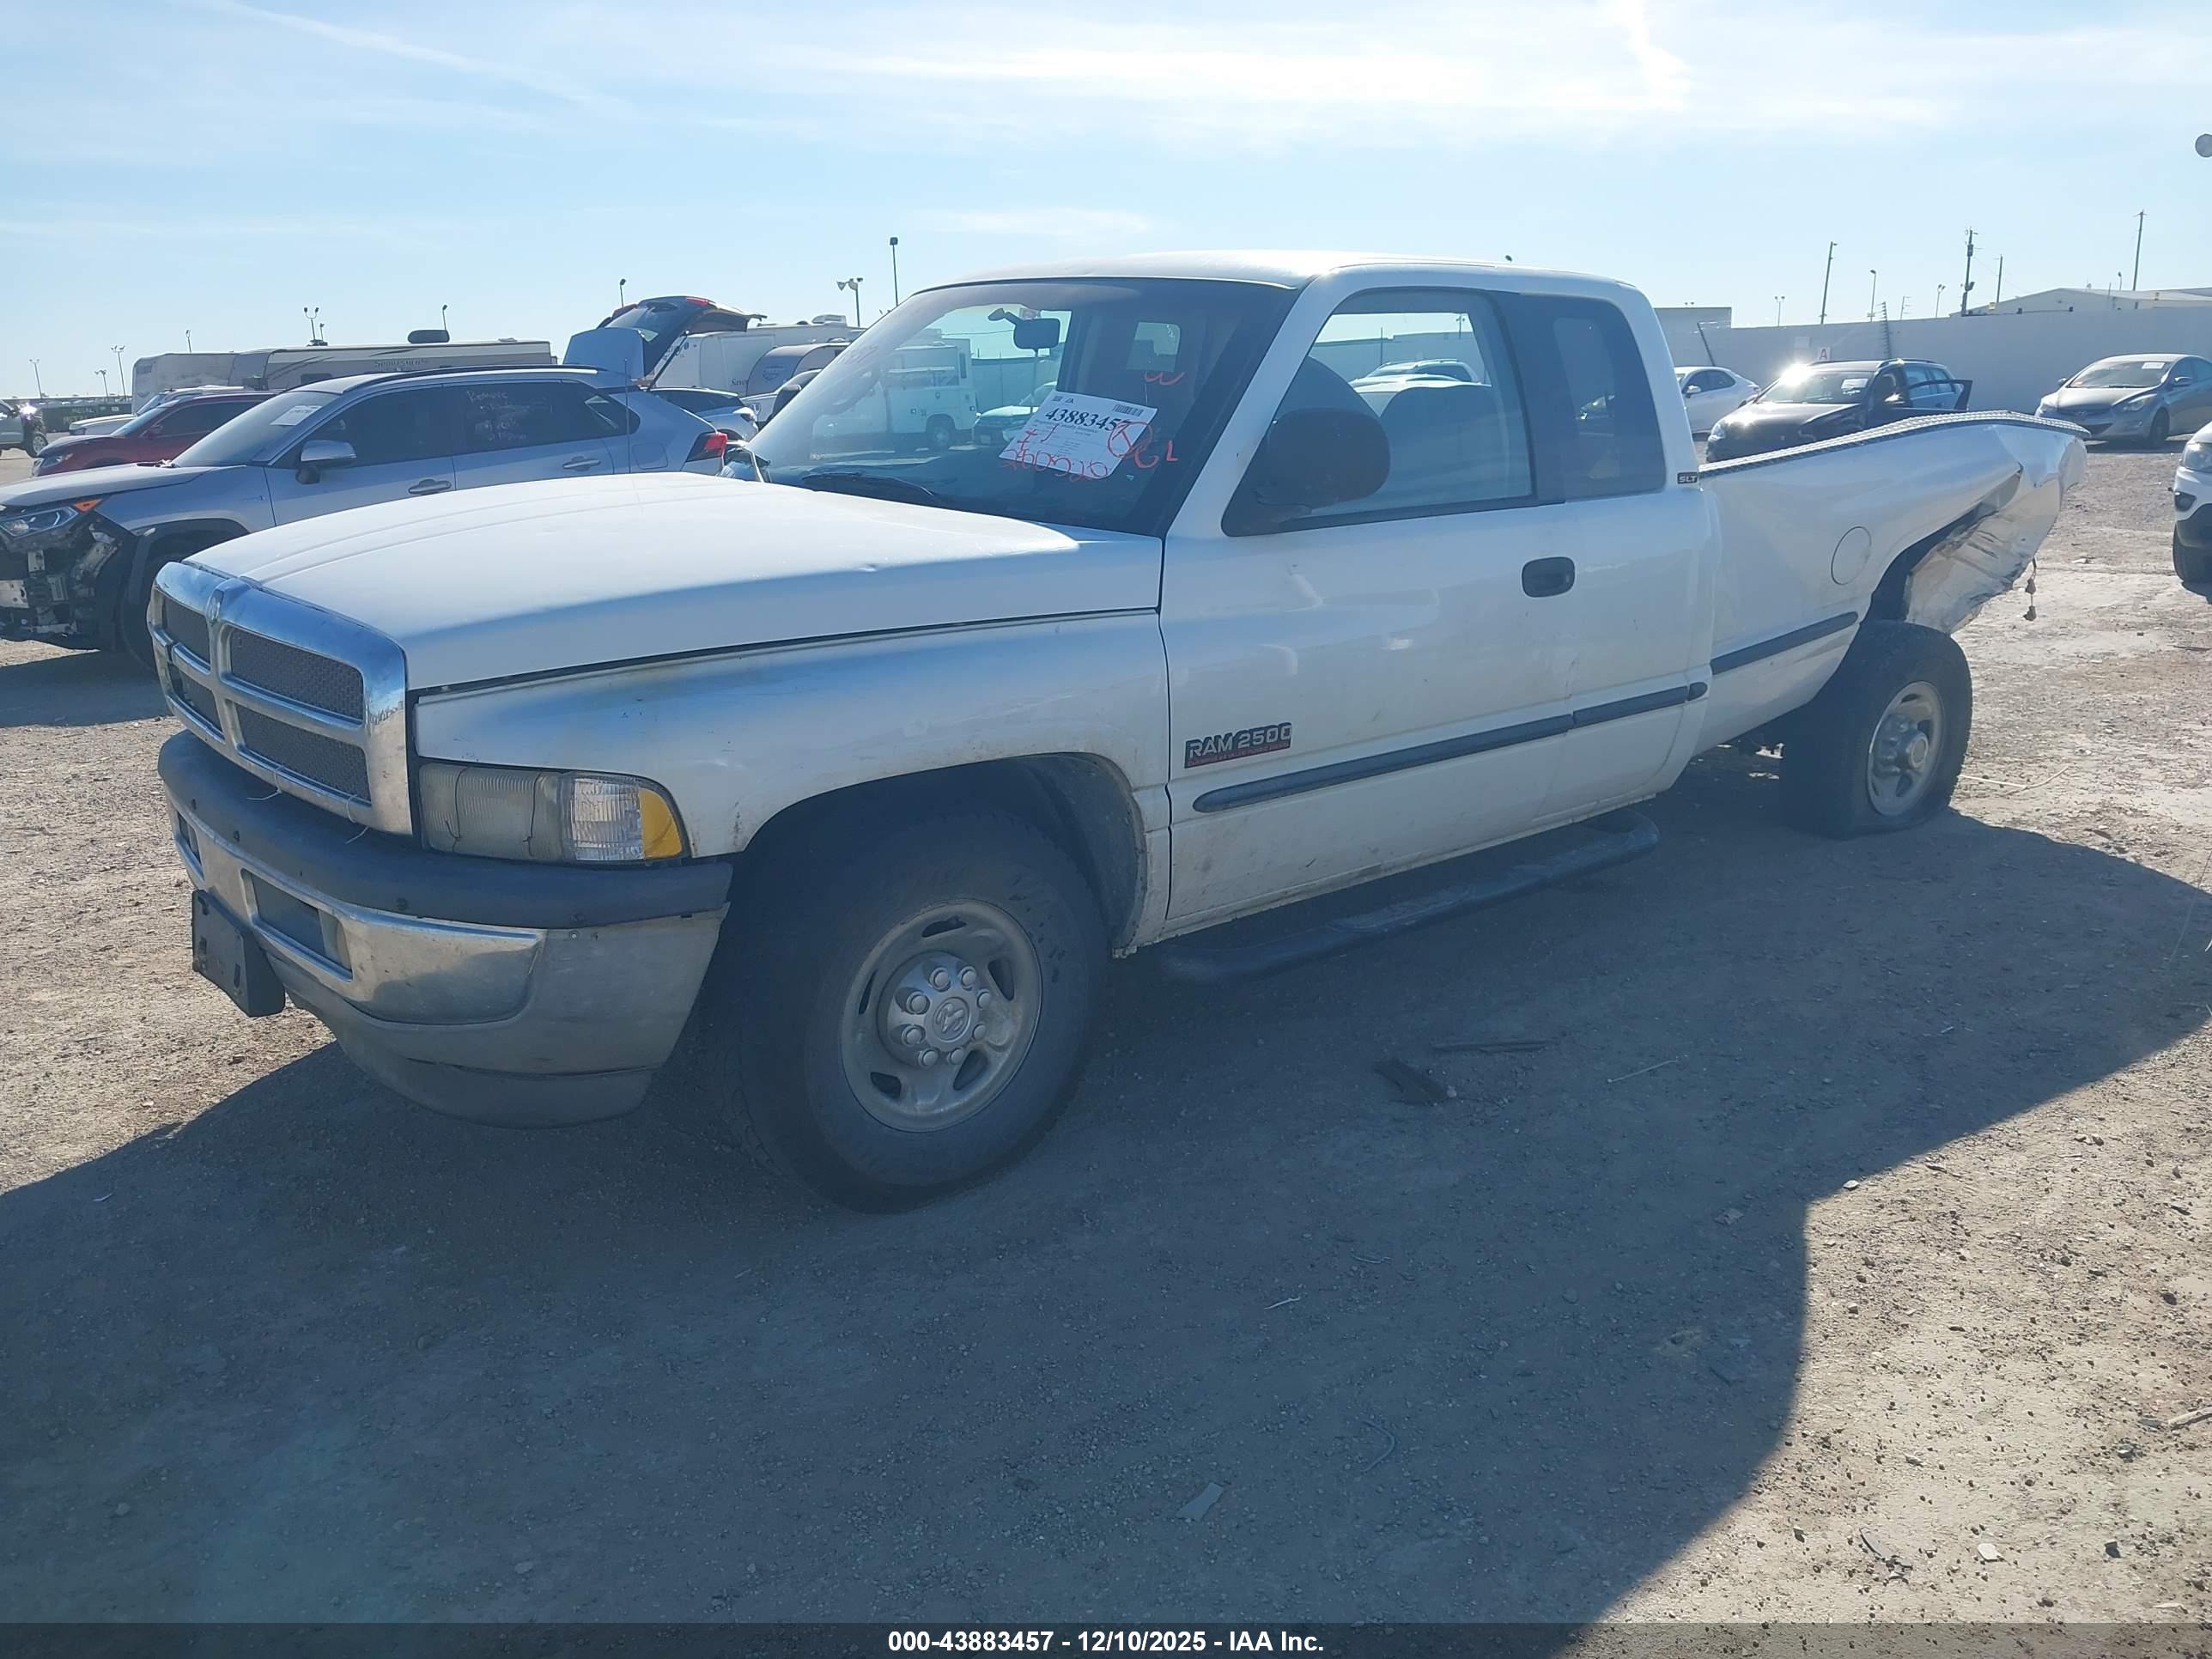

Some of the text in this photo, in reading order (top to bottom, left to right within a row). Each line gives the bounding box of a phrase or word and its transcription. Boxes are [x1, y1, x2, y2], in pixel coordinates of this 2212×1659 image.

[1819, 349, 1828, 360] A
[1189, 736, 1233, 758] RAM
[1237, 725, 1291, 749] 2500
